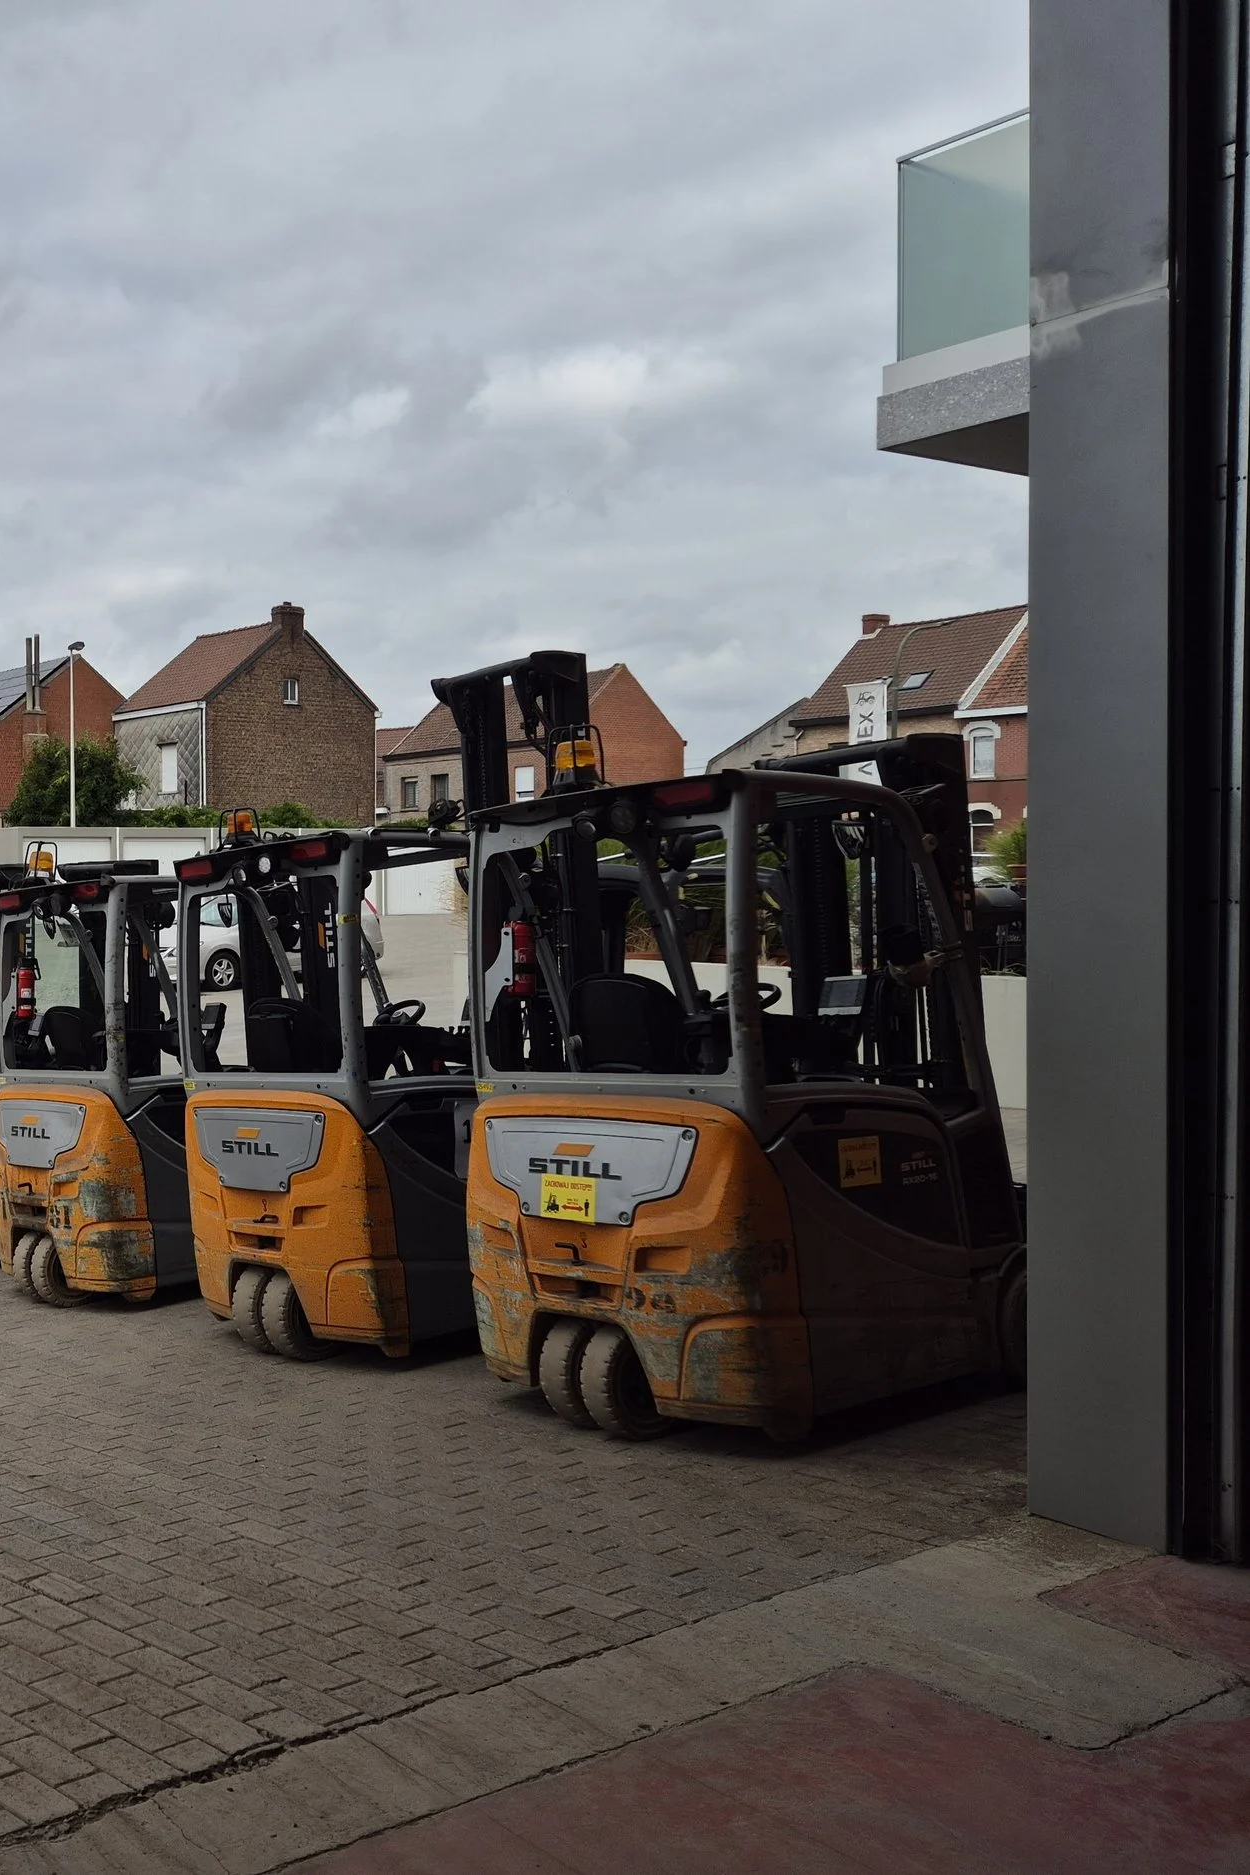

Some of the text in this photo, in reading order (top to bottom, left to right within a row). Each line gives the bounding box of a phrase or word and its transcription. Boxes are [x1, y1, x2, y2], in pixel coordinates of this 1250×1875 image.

[25, 917, 33, 959] TILL
[324, 902, 336, 968] STILL
[11, 1126, 51, 1139] STILL
[222, 1140, 279, 1157] STILL
[529, 1157, 622, 1180] STILL
[900, 1158, 937, 1172] STILL
